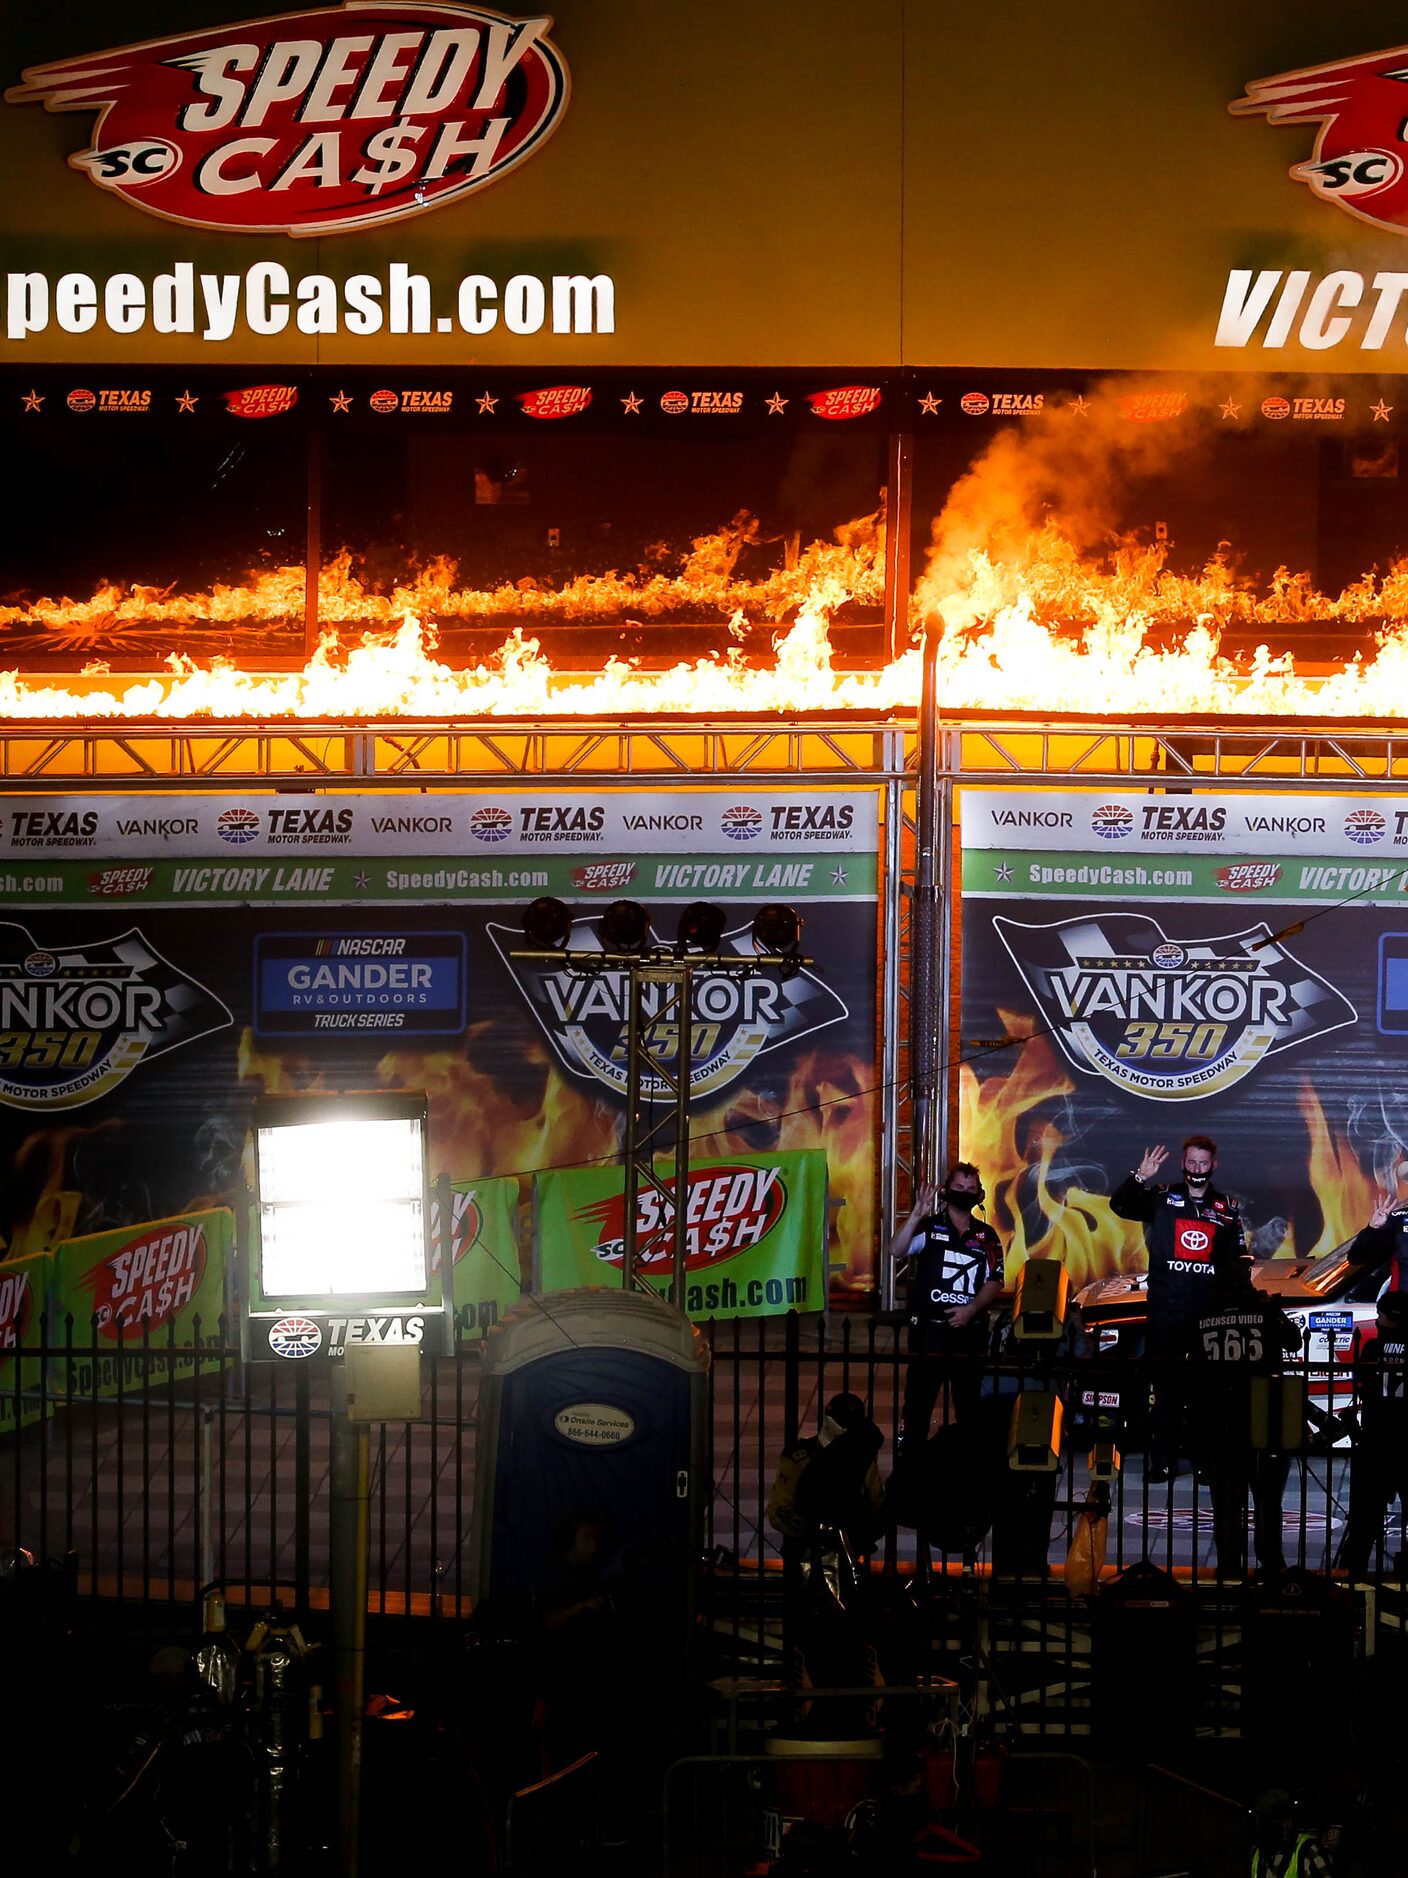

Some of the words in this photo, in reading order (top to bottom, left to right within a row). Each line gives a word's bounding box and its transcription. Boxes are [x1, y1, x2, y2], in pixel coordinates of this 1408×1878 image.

[166, 16, 552, 132] SPEEDY
[92, 146, 168, 177] SC
[1310, 156, 1388, 189] SC
[99, 390, 152, 405] TEXAS
[241, 386, 297, 404] SPEEDY
[691, 392, 743, 407] TEXAS
[992, 394, 1044, 409] TEXAS
[11, 811, 98, 836] TEXAS
[117, 818, 198, 835] VANKOR
[268, 809, 353, 834] TEXAS
[371, 817, 452, 833] VANKOR
[520, 807, 604, 831] TEXAS
[623, 815, 702, 830] VANKOR
[771, 805, 853, 830] TEXAS
[991, 810, 1073, 828] VANKOR
[1142, 806, 1227, 830] TEXAS
[1245, 816, 1326, 833] VANKOR
[11, 837, 45, 846] MOTOR
[46, 838, 97, 847] SPEEDWAY
[268, 835, 300, 844] MOTOR
[302, 835, 352, 844] SPEEDWAY
[520, 832, 553, 841] MOTOR
[553, 832, 603, 841] SPEEDWAY
[771, 831, 802, 840] MOTOR
[804, 831, 852, 840] SPEEDWAY
[1141, 831, 1174, 840] MOTOR
[1175, 832, 1225, 841] SPEEDWAY
[101, 867, 152, 885] SPEEDY
[172, 868, 269, 892] VICTORY
[272, 867, 334, 891] LANE
[387, 869, 548, 890] SpeedyCash.com
[585, 862, 635, 879] SPEEDY
[655, 865, 750, 887] VICTORY
[753, 864, 813, 887] LANE
[1029, 863, 1193, 886] SpeedyCash.com
[1229, 863, 1280, 880] SPEEDY
[1299, 867, 1396, 892] VICTORY
[337, 938, 405, 956] NASCAR
[288, 964, 432, 990] GANDER
[1050, 975, 1290, 1022] VANKOR
[314, 1013, 356, 1028] TRUCK
[357, 1013, 404, 1028] SERIES
[0, 1031, 102, 1068] 350
[1117, 1022, 1228, 1059] 350
[590, 1051, 624, 1082] TEXAS
[1094, 1049, 1127, 1079] TEXAS
[1130, 1072, 1175, 1089] MOTOR
[1177, 1051, 1238, 1088] SPEEDWAY
[3, 1083, 48, 1099] MOTOR
[51, 1059, 113, 1098] SPEEDWAY
[108, 1223, 204, 1299] SPEEDY
[1167, 1260, 1216, 1275] TOYOTA
[328, 1316, 425, 1345] TEXAS
[1199, 1314, 1237, 1330] LICENSED
[1238, 1314, 1264, 1326] VIDEO
